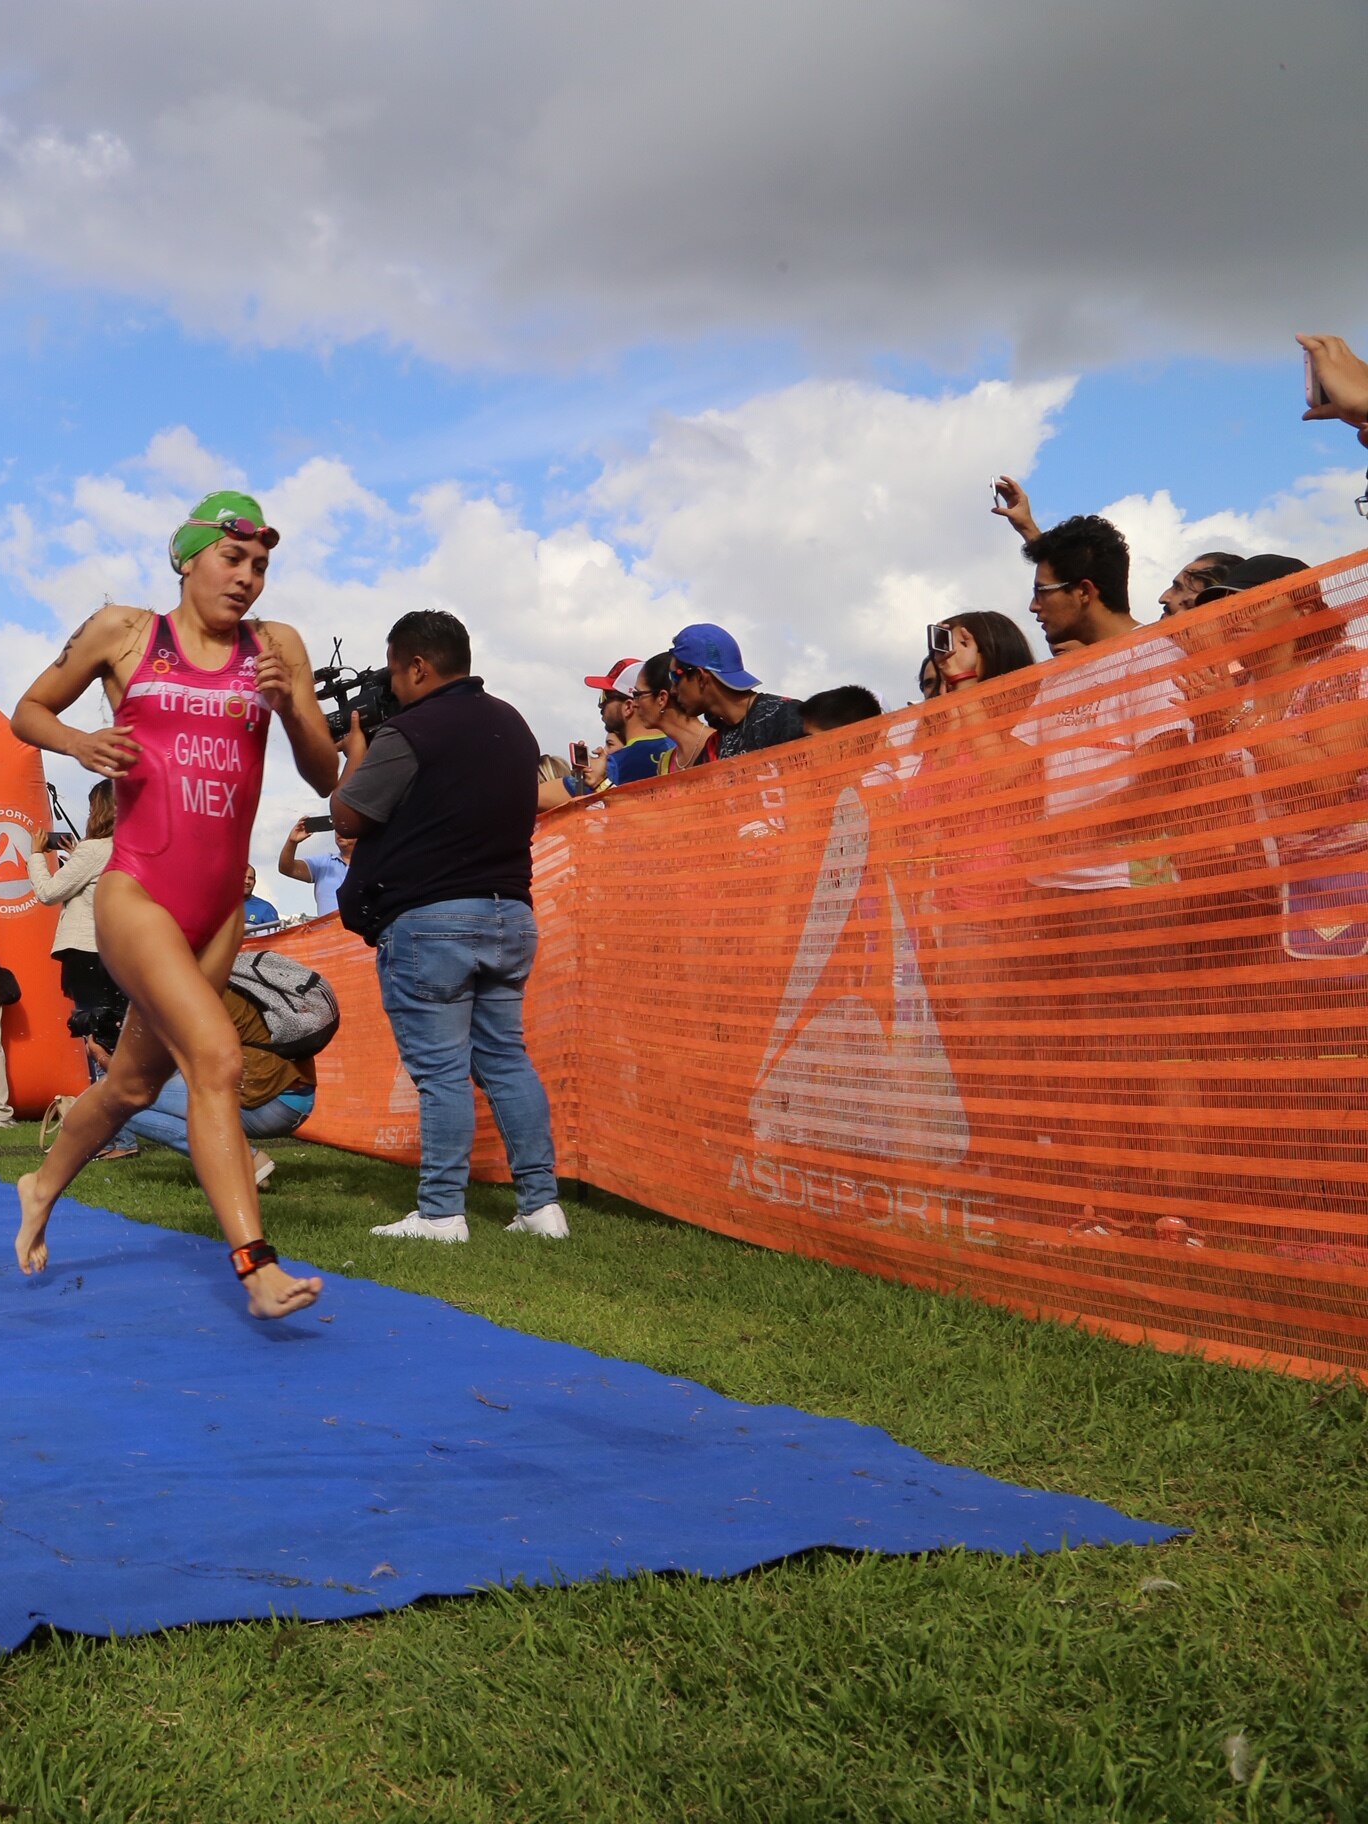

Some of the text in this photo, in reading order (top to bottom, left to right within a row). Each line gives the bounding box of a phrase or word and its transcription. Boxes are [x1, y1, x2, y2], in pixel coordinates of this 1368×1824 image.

[174, 732, 242, 772] GARCIA
[180, 775, 238, 819] MEX
[728, 1153, 998, 1247] ASDEPORTE
